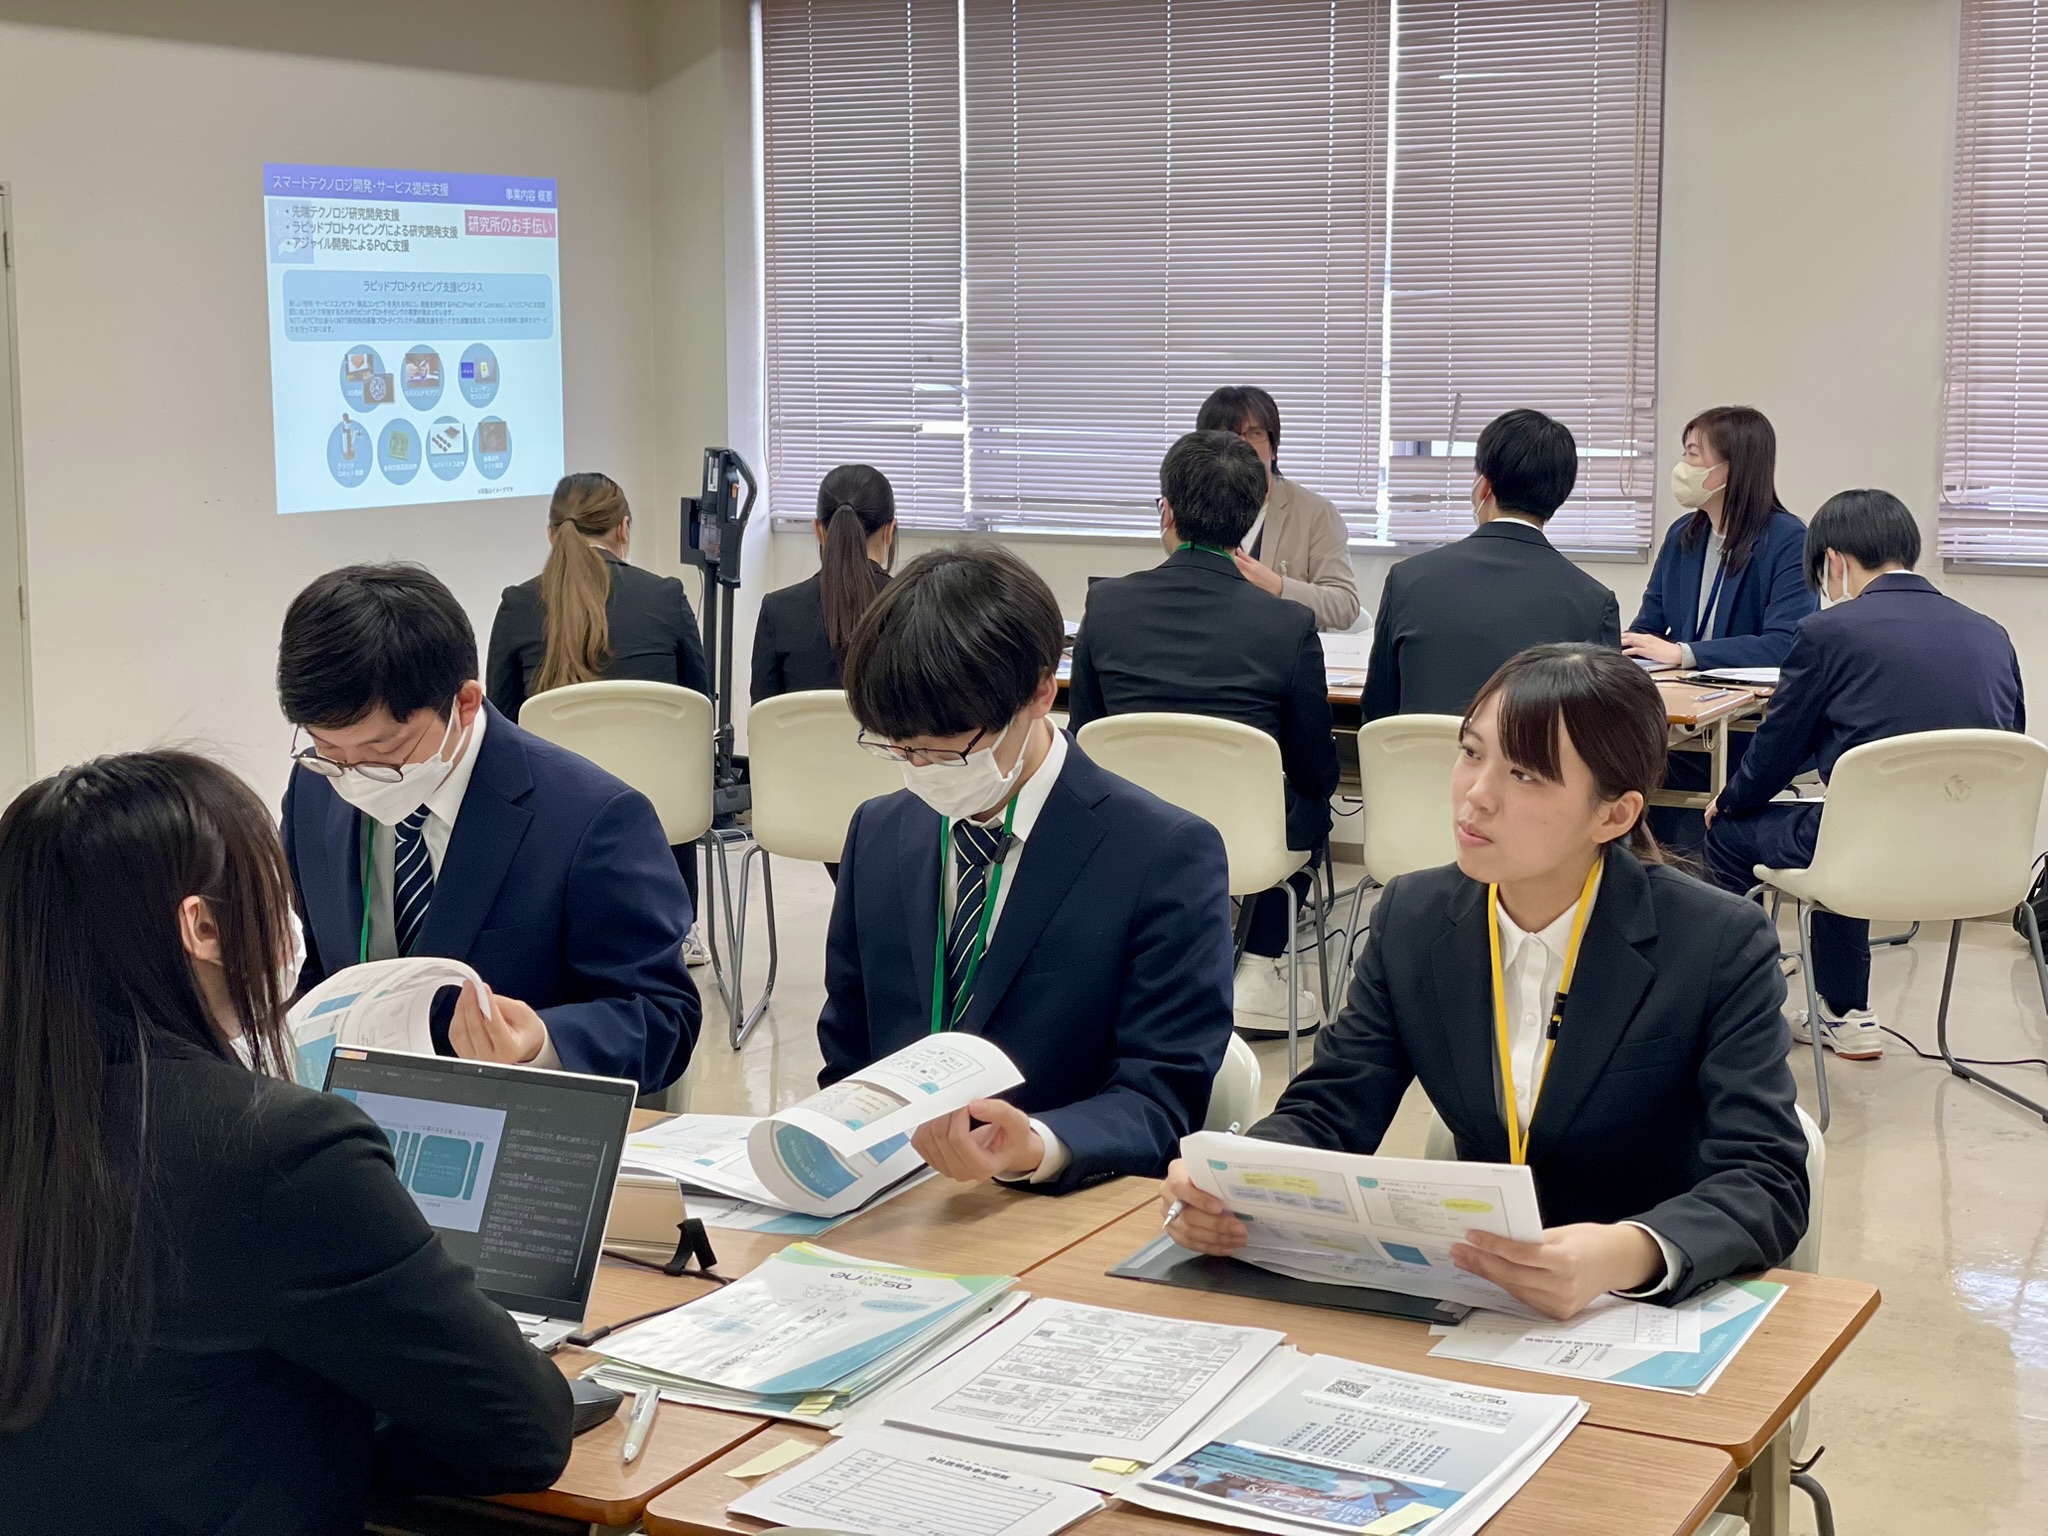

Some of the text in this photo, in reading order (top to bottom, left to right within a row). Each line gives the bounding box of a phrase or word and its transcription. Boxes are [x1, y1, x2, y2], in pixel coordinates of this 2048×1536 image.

[273, 175, 449, 197] スマートテクノロジ開発・サービス提供支援
[505, 188, 553, 203] 事業内容 概要
[292, 206, 400, 222] 先端テクノロジ研究開発支援
[292, 220, 458, 239] ラピッドプロトタイピングによる研究開発支援
[467, 215, 553, 235] 研究所のお手伝い
[293, 237, 410, 253] アジャイル開発によるPoC支援
[363, 280, 484, 293] ラピッドプロトタイピング支援ビジネス
